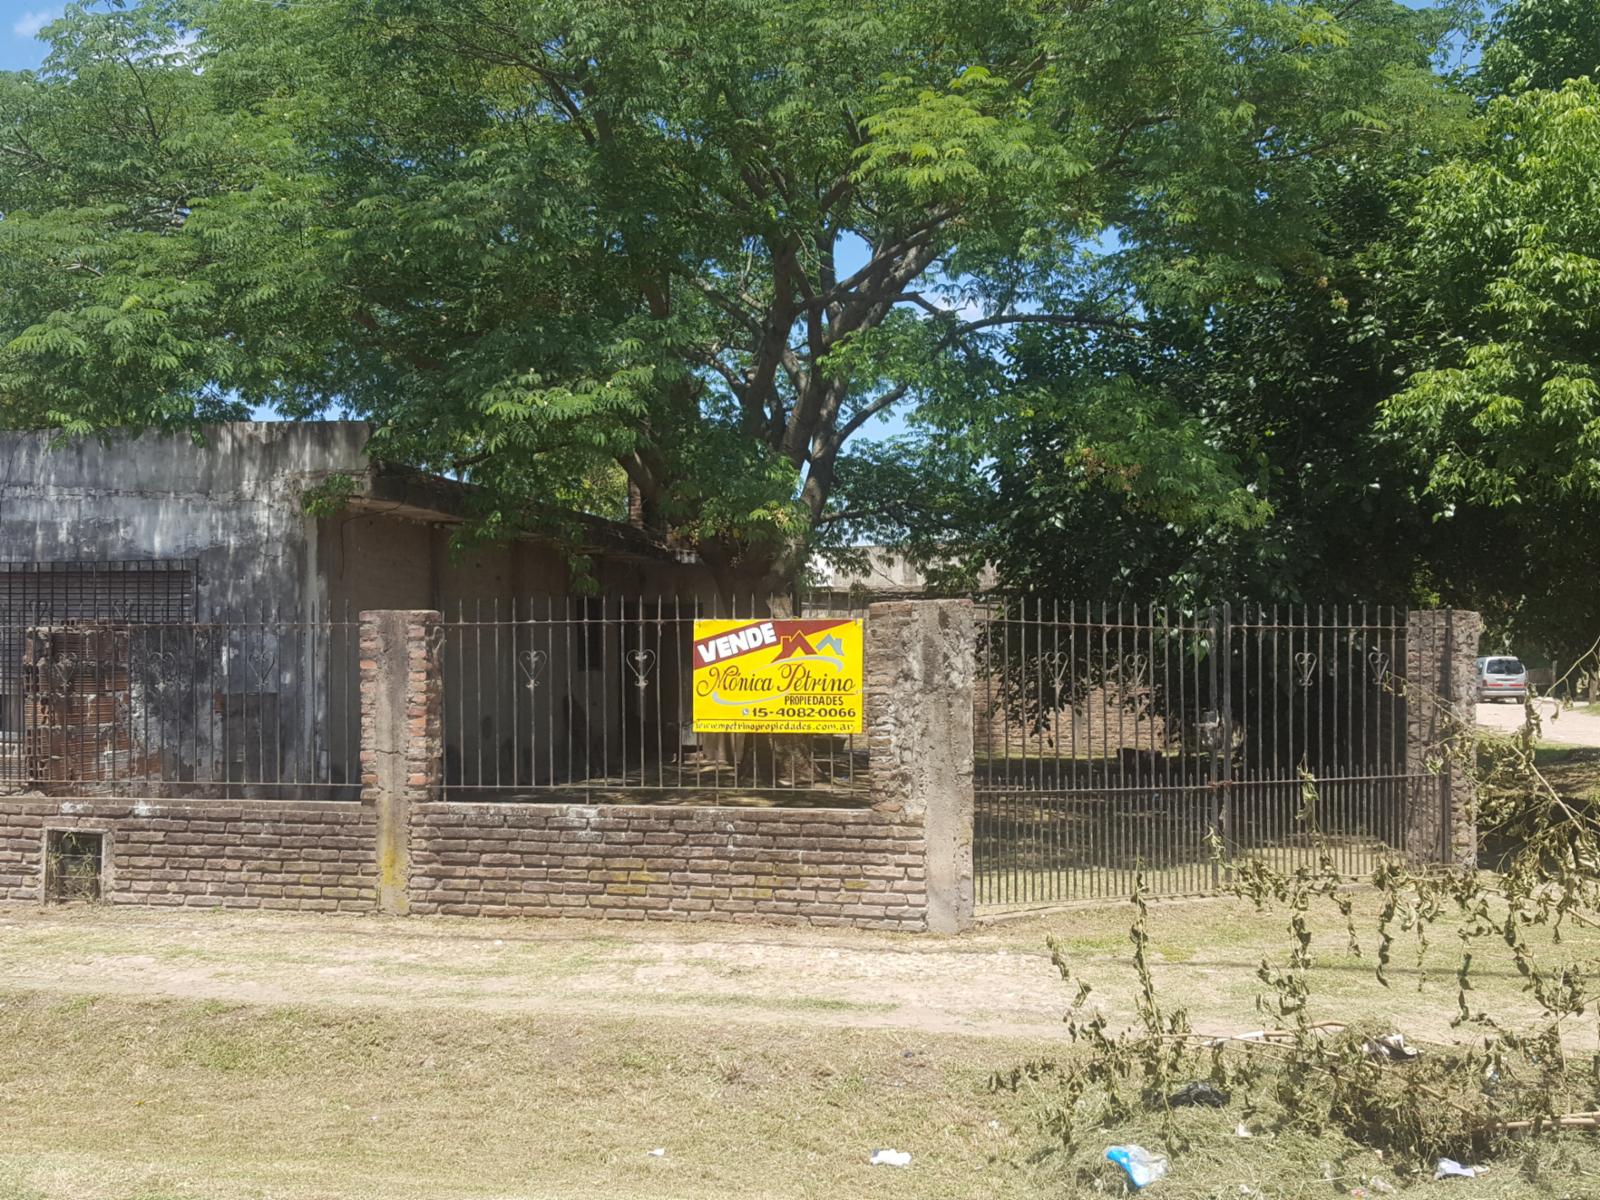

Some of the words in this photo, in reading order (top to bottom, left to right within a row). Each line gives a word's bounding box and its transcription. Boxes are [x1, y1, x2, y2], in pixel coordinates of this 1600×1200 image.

[697, 622, 777, 663] VENDE
[696, 665, 773, 697] Mónica
[777, 664, 855, 692] Petrino
[784, 695, 844, 706] PROPIEDADES
[752, 707, 856, 718] 15-4082-0066
